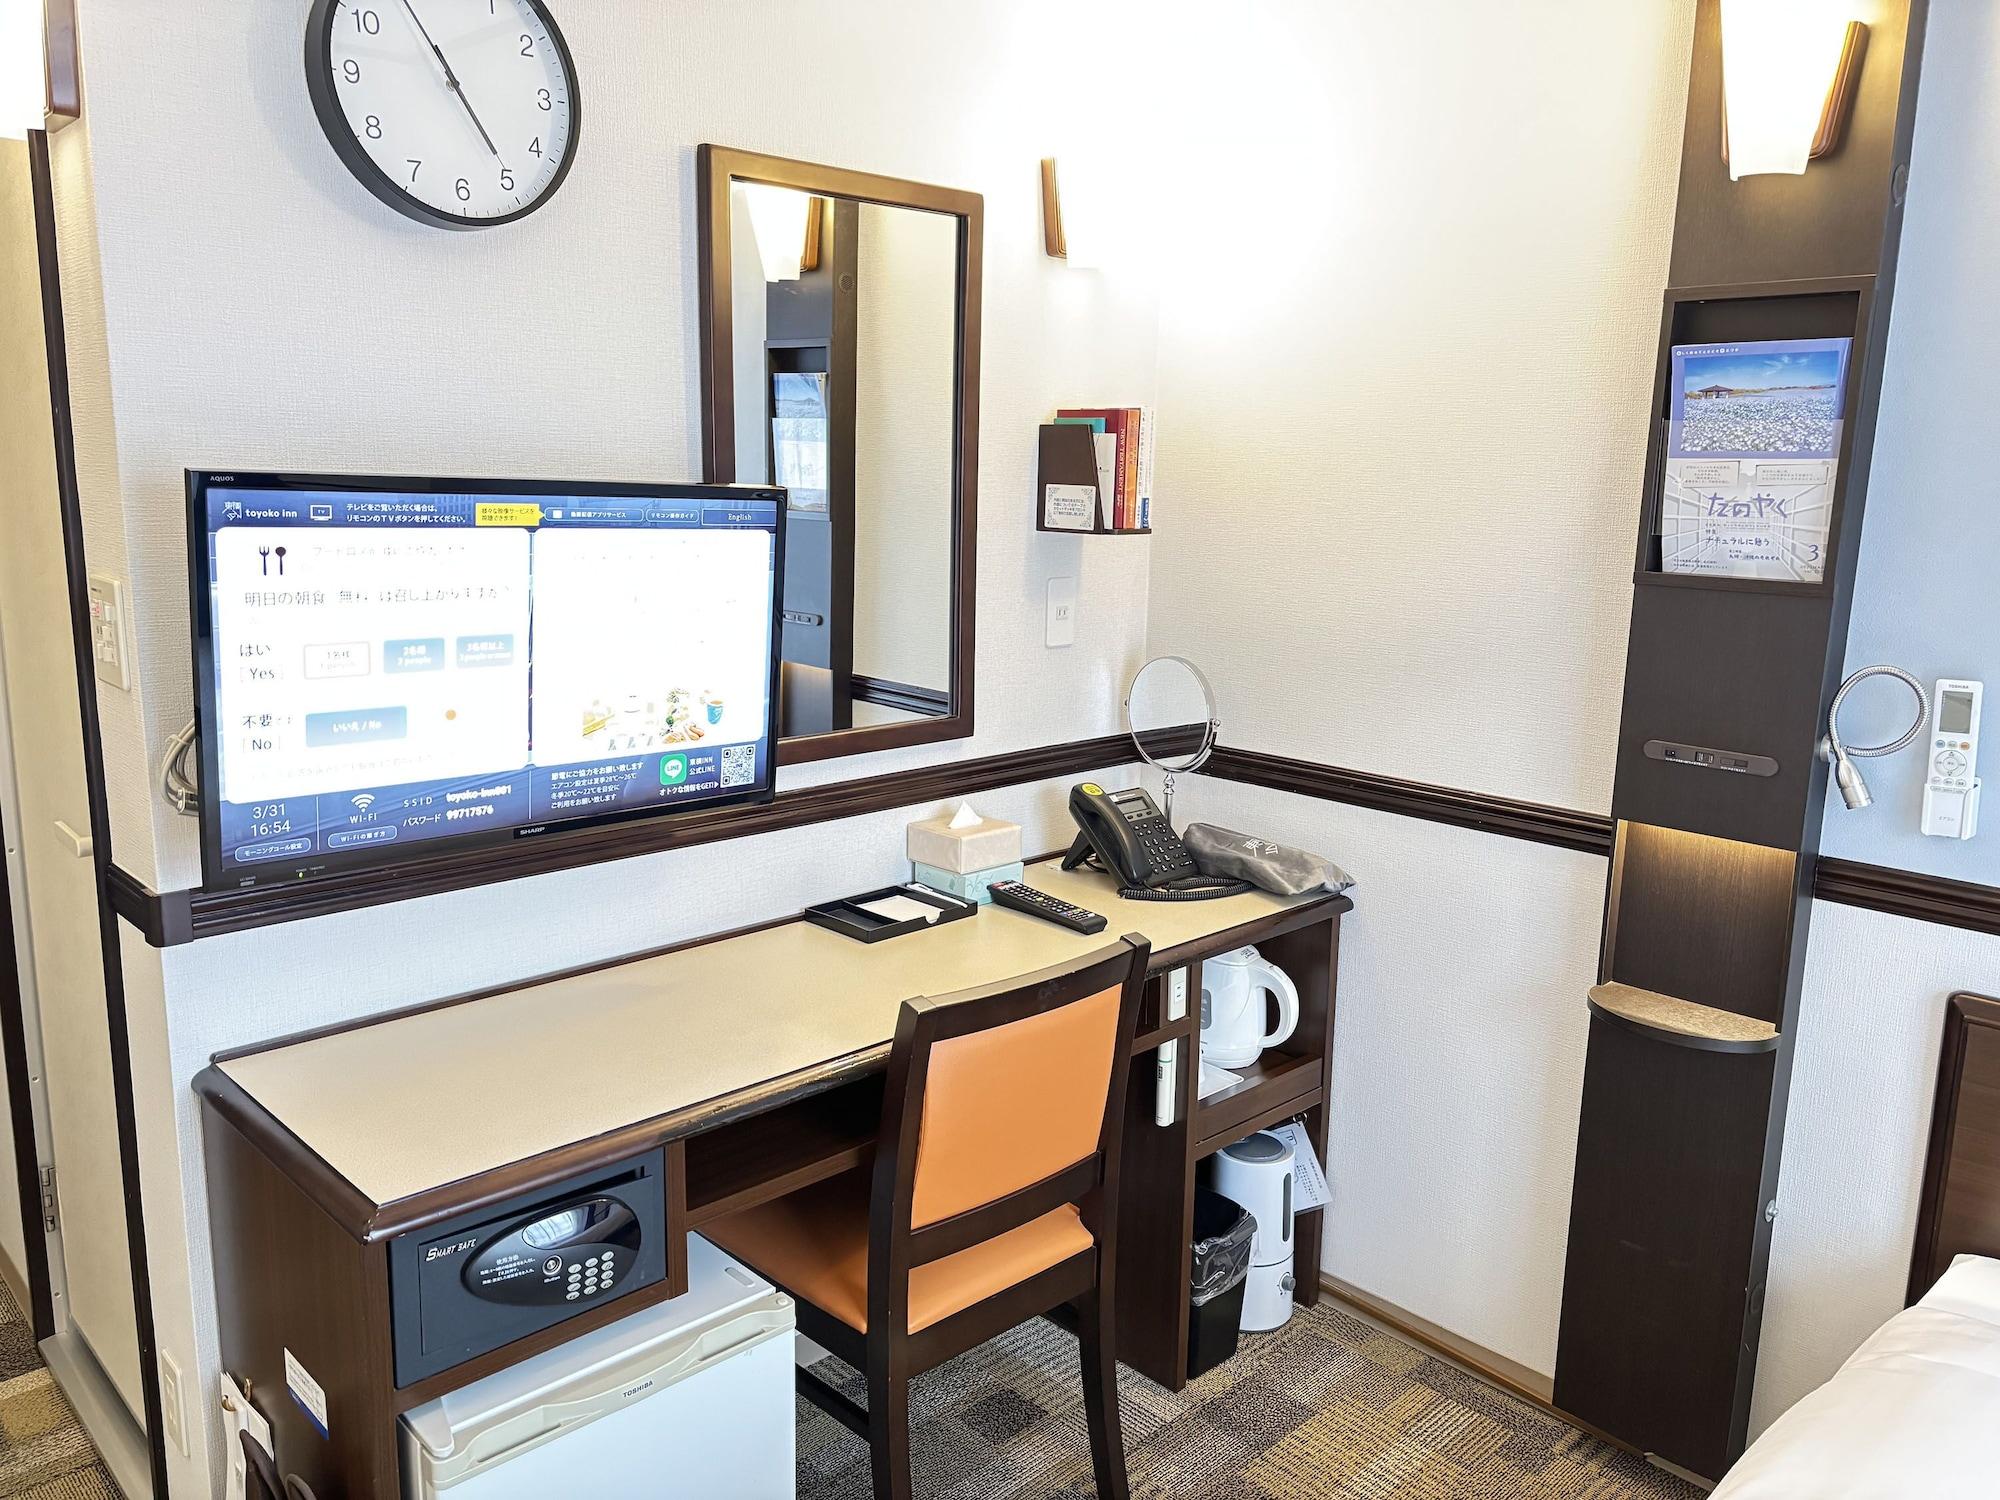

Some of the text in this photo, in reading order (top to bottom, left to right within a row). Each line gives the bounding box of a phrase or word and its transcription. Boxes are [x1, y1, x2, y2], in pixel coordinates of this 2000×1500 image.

[351, 8, 380, 35] 10
[519, 34, 534, 57] 2
[343, 59, 361, 84] 9
[537, 88, 552, 111] 3
[365, 115, 382, 139] 8
[528, 136, 543, 158] 4
[407, 159, 422, 182] 7
[500, 169, 514, 191] 5
[455, 178, 471, 201] 6
[245, 508, 298, 519] toyoko inn
[728, 512, 752, 522] English
[1807, 544, 1819, 562] 3
[239, 643, 271, 657] はい
[249, 667, 275, 680] Yes
[251, 738, 272, 751] No
[252, 803, 286, 819] 3/31
[403, 796, 433, 808] SSID
[250, 819, 292, 837] 16:54
[403, 814, 441, 827] パスワード
[519, 826, 546, 836] SHARP
[425, 1238, 477, 1262] SMART SAFE
[623, 1380, 653, 1398] TOSHIBA
